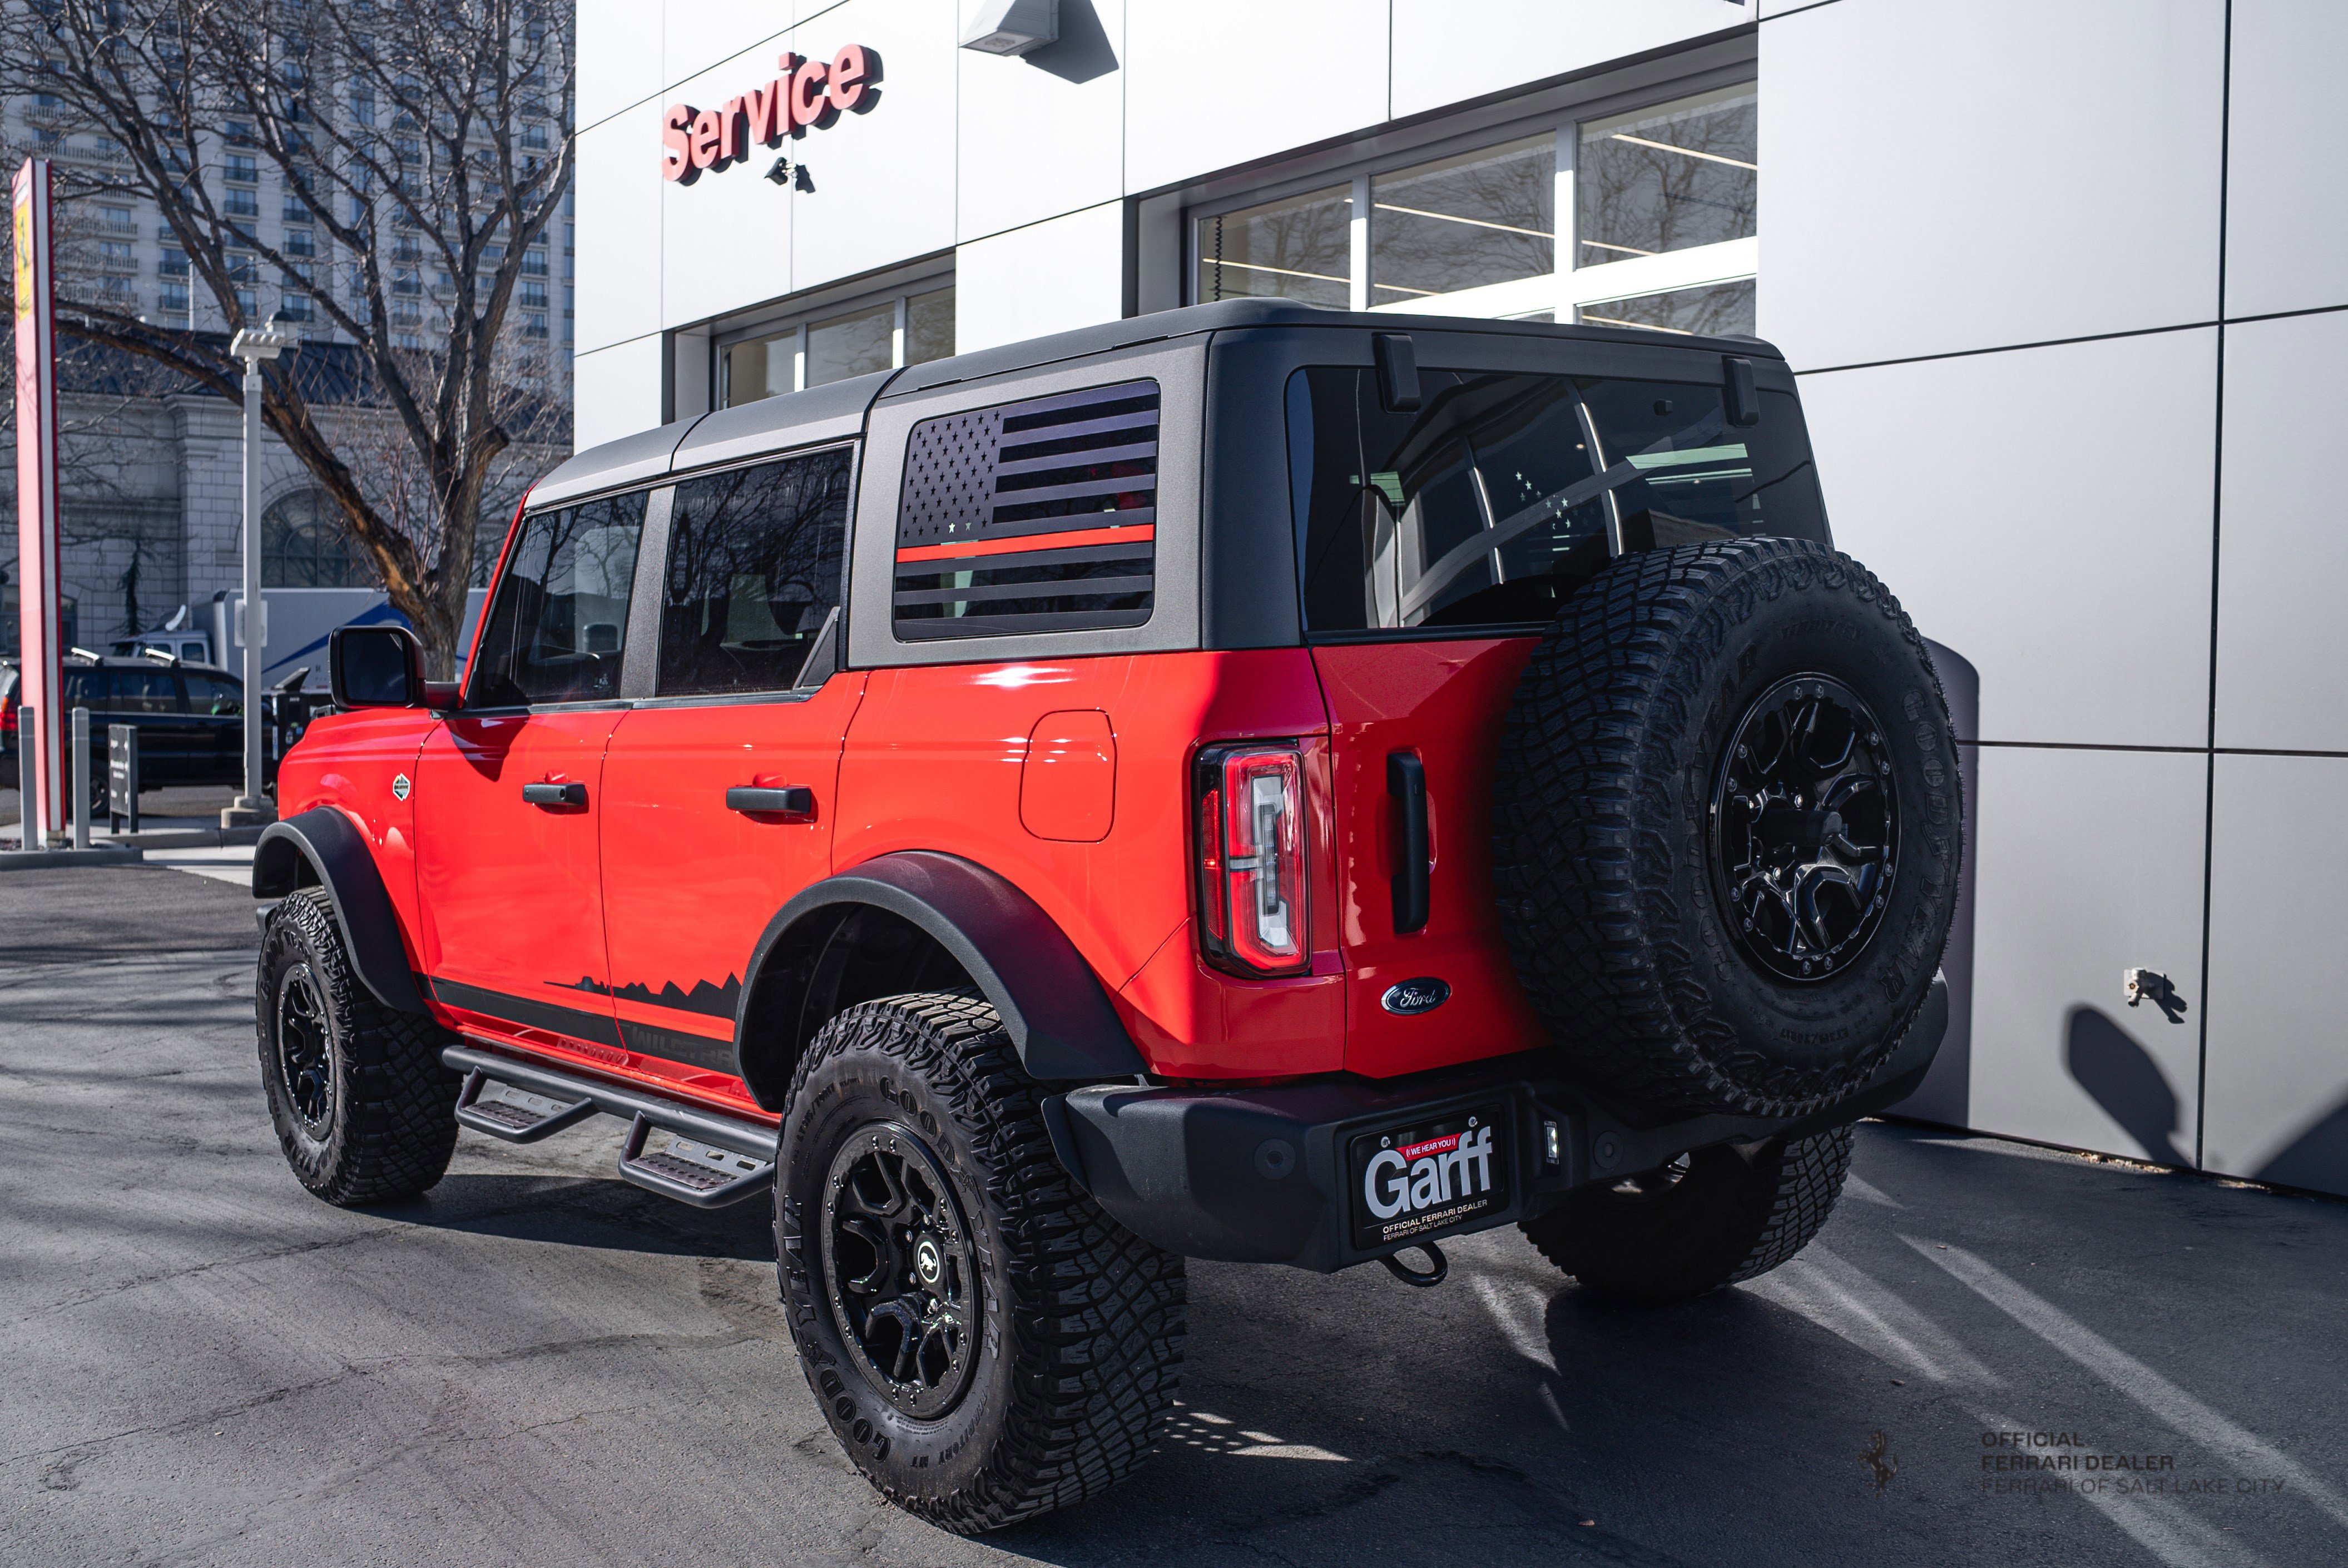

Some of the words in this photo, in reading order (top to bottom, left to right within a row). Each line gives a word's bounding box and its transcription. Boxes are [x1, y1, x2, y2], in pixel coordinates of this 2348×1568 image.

[662, 43, 870, 182] Service
[1399, 988, 1436, 1008] Ford
[632, 1025, 737, 1069] WILDTRA
[1411, 1146, 1421, 1155] WE
[1421, 1142, 1438, 1153] HEAR
[1438, 1138, 1452, 1149] YOU
[1365, 1125, 1493, 1219] Garff
[1383, 1218, 1421, 1234] OFFICIAL
[1421, 1208, 1456, 1223] FERRARI
[1457, 1199, 1488, 1214] DEALER
[1383, 1229, 1409, 1242] FERRARI
[1419, 1222, 1433, 1232] SALT
[1433, 1218, 1449, 1228] LAKE
[1449, 1214, 1463, 1223] CITY
